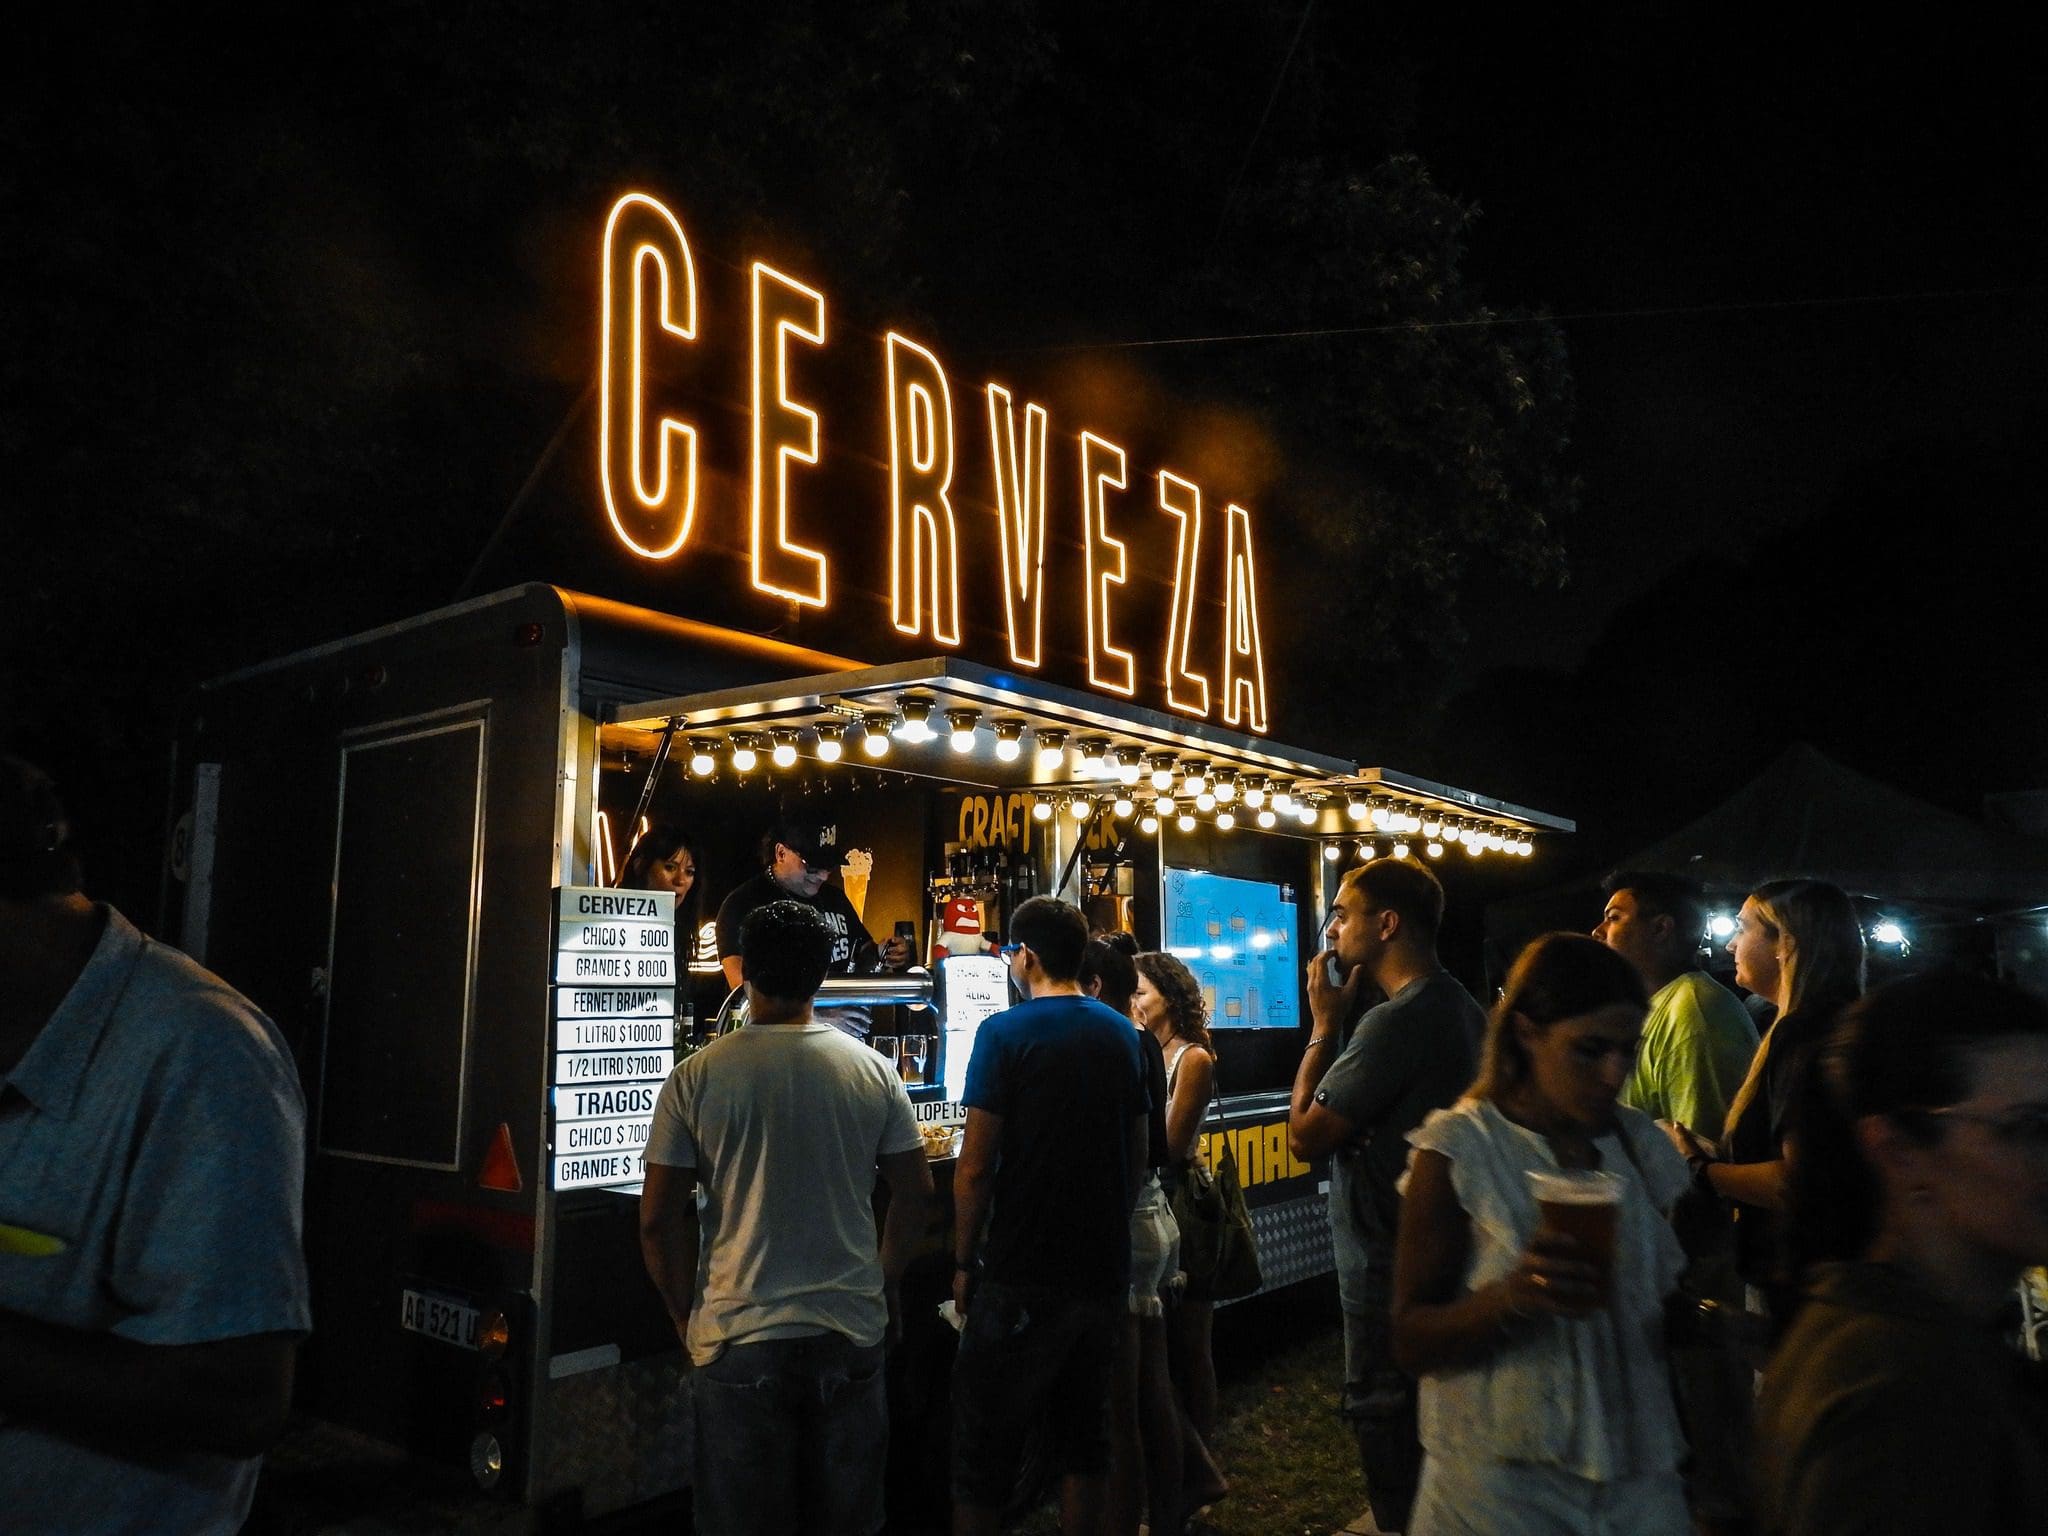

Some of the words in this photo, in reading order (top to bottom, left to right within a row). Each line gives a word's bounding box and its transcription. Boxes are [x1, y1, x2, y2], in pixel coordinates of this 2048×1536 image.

[599, 192, 1268, 734] CERVEZA
[959, 793, 1035, 854] CRAFT
[579, 895, 658, 917] CERVEZA
[583, 926, 616, 946] CHICO
[640, 929, 669, 947] 5000
[576, 958, 621, 977] GRANDE
[638, 960, 667, 977] 8000
[573, 992, 614, 1013] FERNET
[616, 991, 658, 1012] BRANCA
[575, 1027, 580, 1044] 1
[585, 1025, 616, 1044] LITRO
[567, 1058, 589, 1077] 1/2
[592, 1057, 623, 1076] LITRO
[574, 1088, 653, 1116] TRAGOS
[569, 1126, 612, 1148] CHICO
[561, 1157, 619, 1181] GRANDE
[430, 1302, 460, 1341] 521
